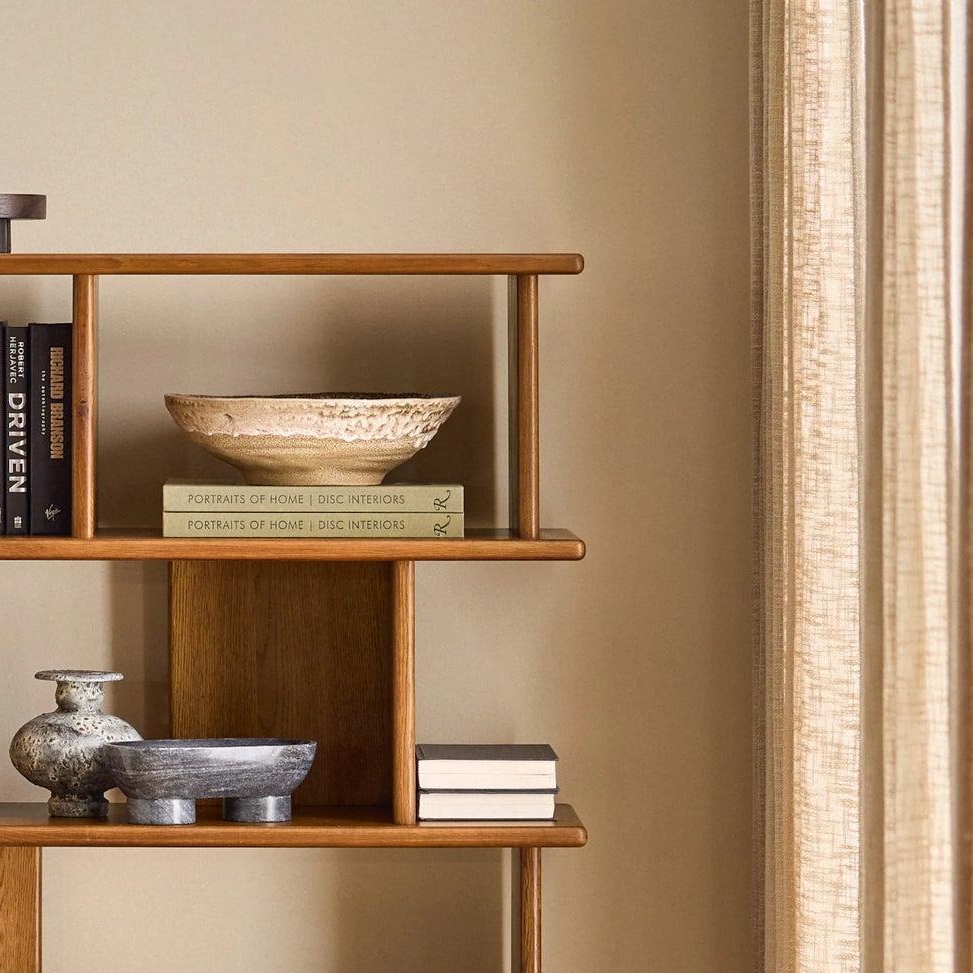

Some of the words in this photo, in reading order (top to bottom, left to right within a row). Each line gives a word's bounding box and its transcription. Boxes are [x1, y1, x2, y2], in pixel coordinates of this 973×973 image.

[9, 337, 17, 383] HERJAVEC
[50, 347, 64, 399] RICHARD
[8, 393, 26, 493] DRIVEN
[50, 403, 64, 459] BRANSON
[187, 494, 246, 505] PORTRAITS
[250, 494, 266, 505] OF
[269, 494, 304, 505] HOME
[318, 494, 344, 505] DISC
[348, 494, 405, 505] INTERIORS
[187, 520, 246, 530] PORTRAITS
[250, 520, 266, 530] OF
[269, 520, 304, 530] HOME
[318, 520, 344, 530] DISC
[348, 520, 405, 531] INTERIORS
